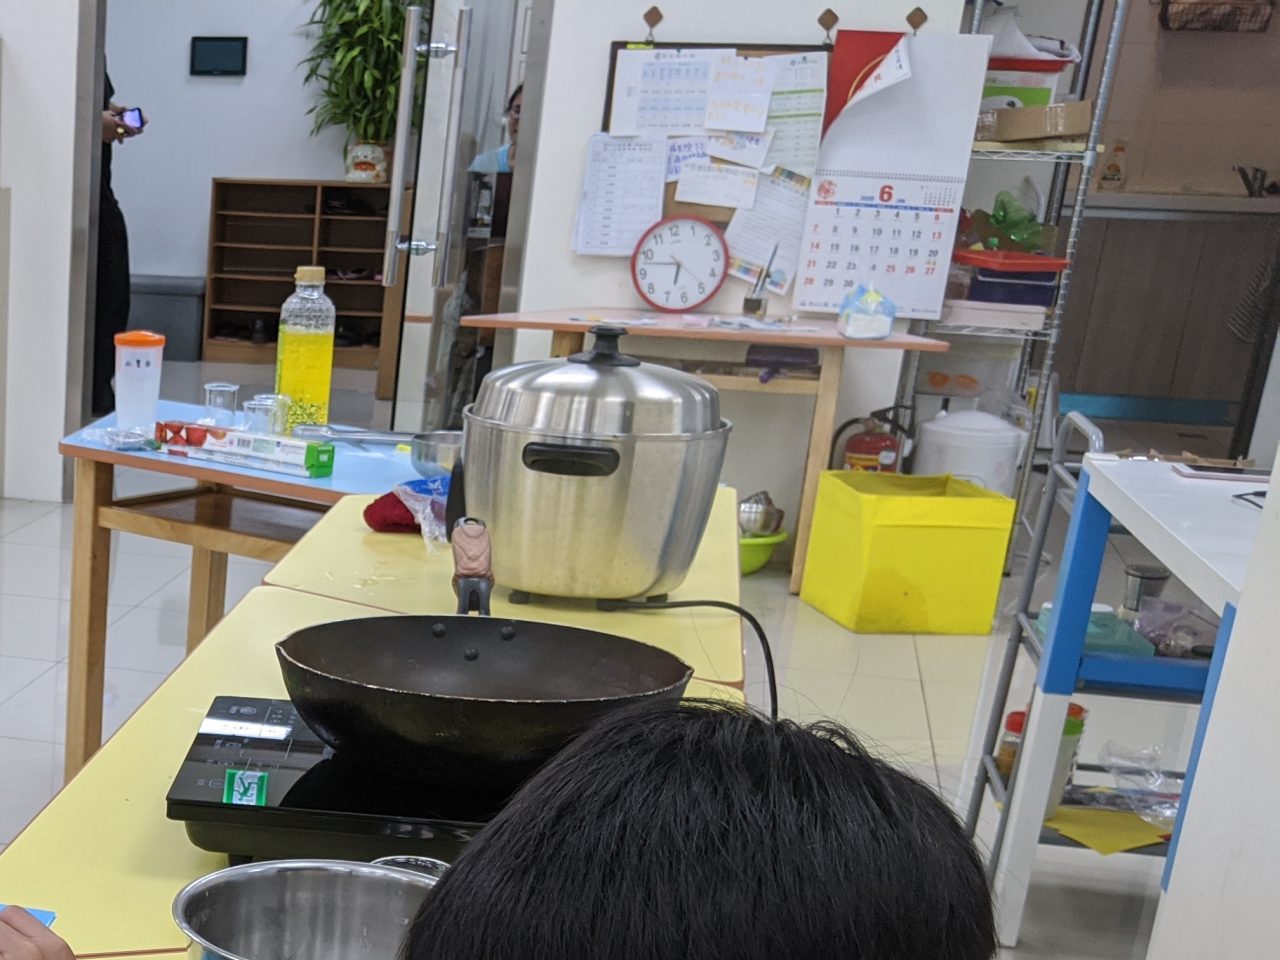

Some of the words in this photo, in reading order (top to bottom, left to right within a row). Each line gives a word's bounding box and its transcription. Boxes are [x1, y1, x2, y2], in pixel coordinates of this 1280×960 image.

[879, 185, 893, 202] 6
[669, 224, 679, 236] 12
[691, 225, 695, 236] 1
[872, 228, 882, 236] 10
[912, 230, 921, 238] 12
[932, 232, 941, 240] 13
[654, 233, 663, 245] 11
[704, 234, 711, 246] 2
[642, 248, 654, 260] 10
[810, 242, 820, 250] 14
[830, 243, 839, 251] 15
[850, 244, 859, 252] 16
[890, 247, 899, 255] 18
[909, 248, 918, 256] 19
[928, 249, 938, 257] 20
[712, 250, 719, 262] 3
[709, 268, 716, 278] 4
[807, 260, 816, 268] 21
[827, 261, 837, 269] 22
[846, 262, 856, 270] 23
[886, 264, 896, 273] 25
[905, 266, 915, 274] 26
[925, 267, 935, 275] 27
[640, 268, 646, 280] 9
[647, 282, 655, 294] 8
[698, 282, 705, 294] 5
[804, 277, 814, 285] 28
[823, 278, 833, 286] 29
[843, 280, 854, 288] 30
[664, 291, 670, 303] 7
[680, 291, 688, 304] 6
